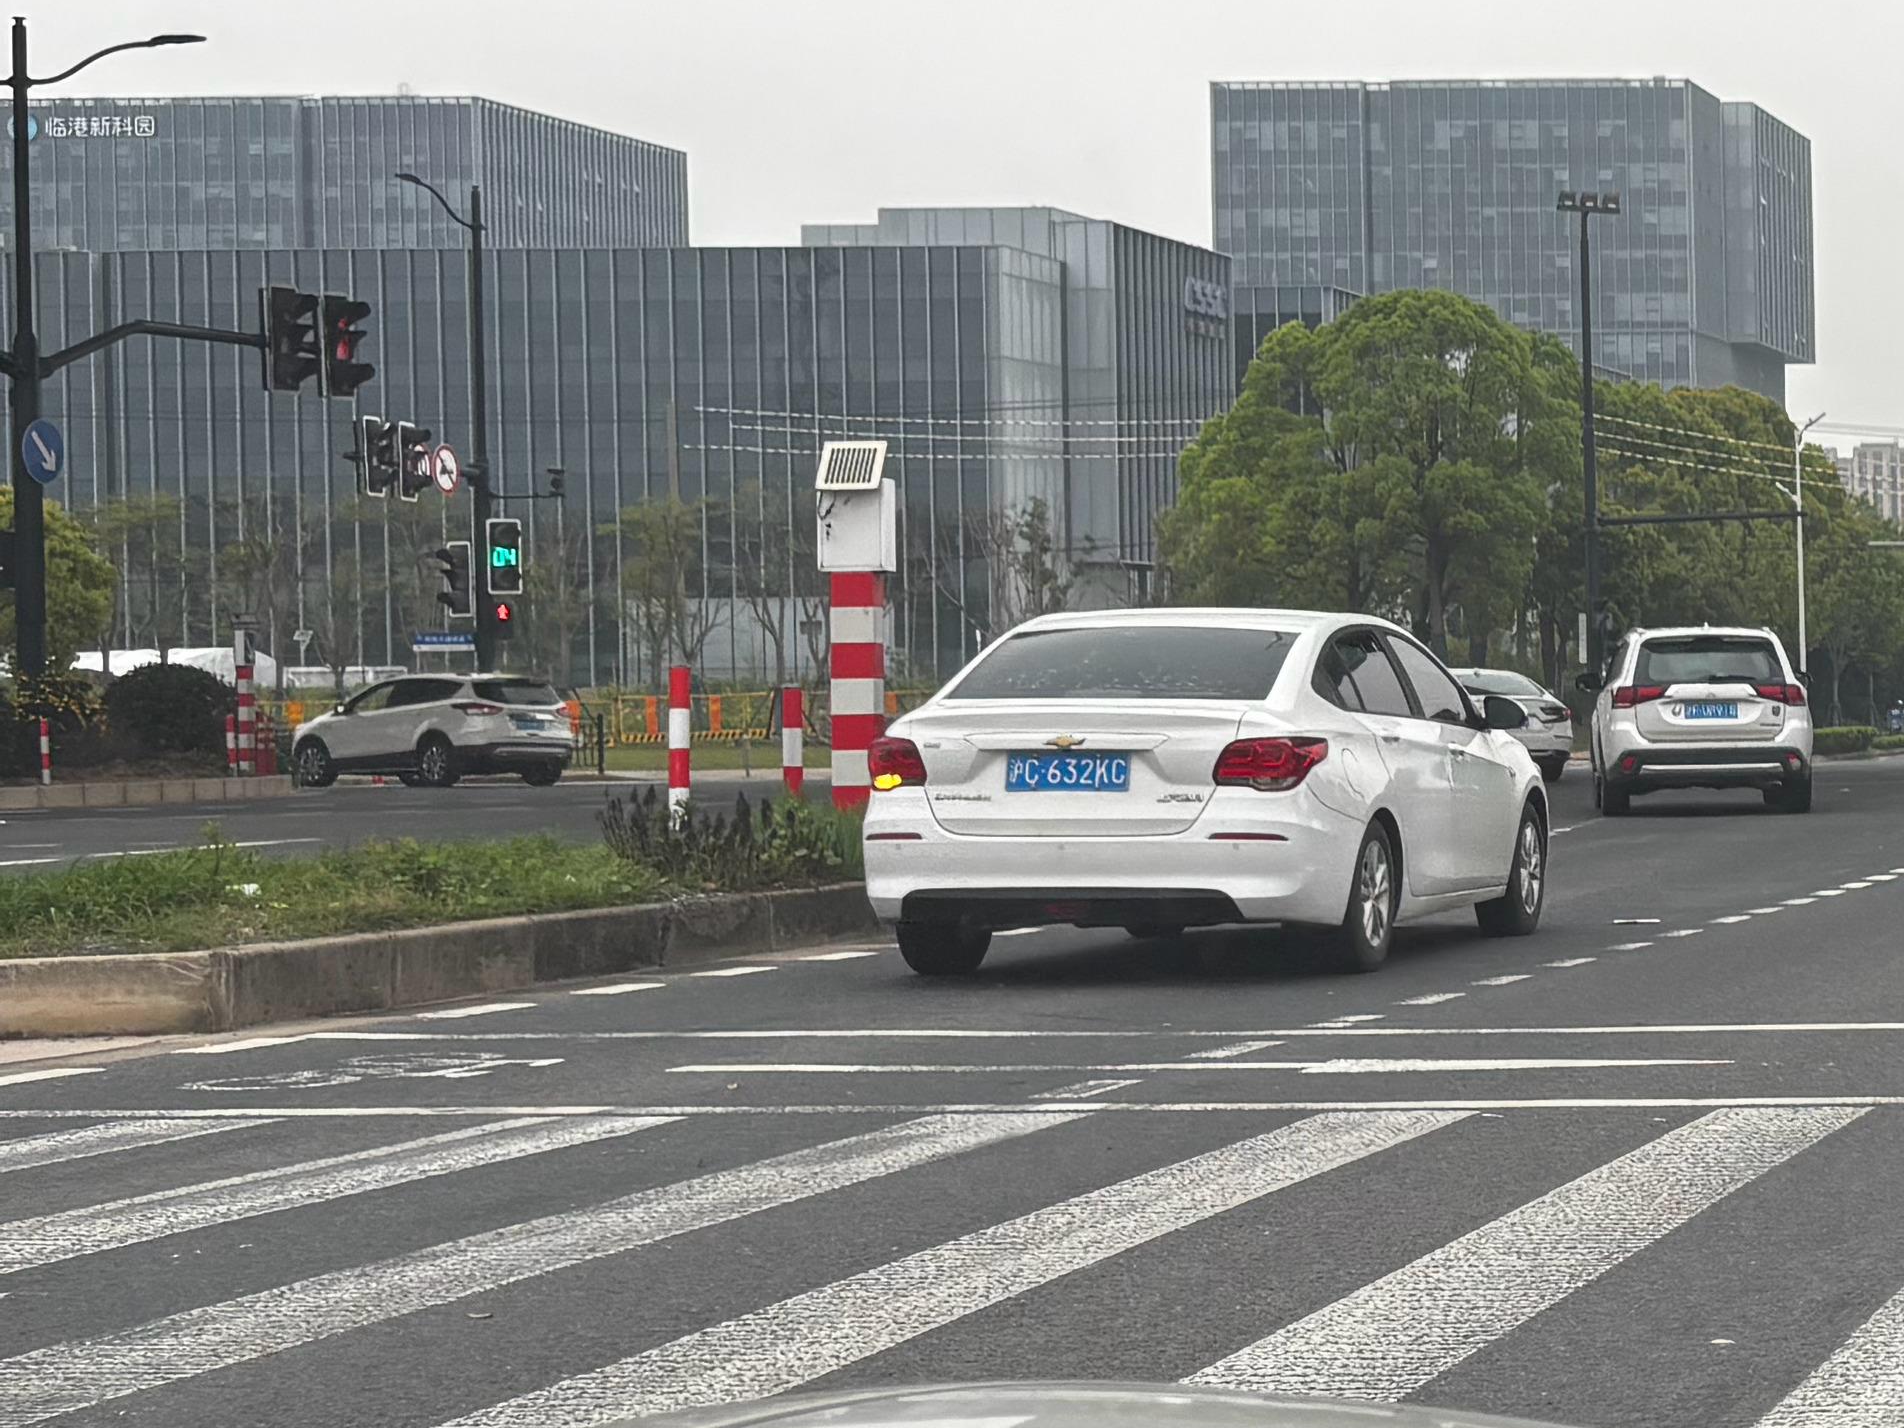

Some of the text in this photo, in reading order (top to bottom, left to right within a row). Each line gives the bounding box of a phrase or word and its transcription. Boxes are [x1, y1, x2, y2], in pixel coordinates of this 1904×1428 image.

[45, 116, 155, 137] 临港新科园
[492, 546, 517, 567] 04
